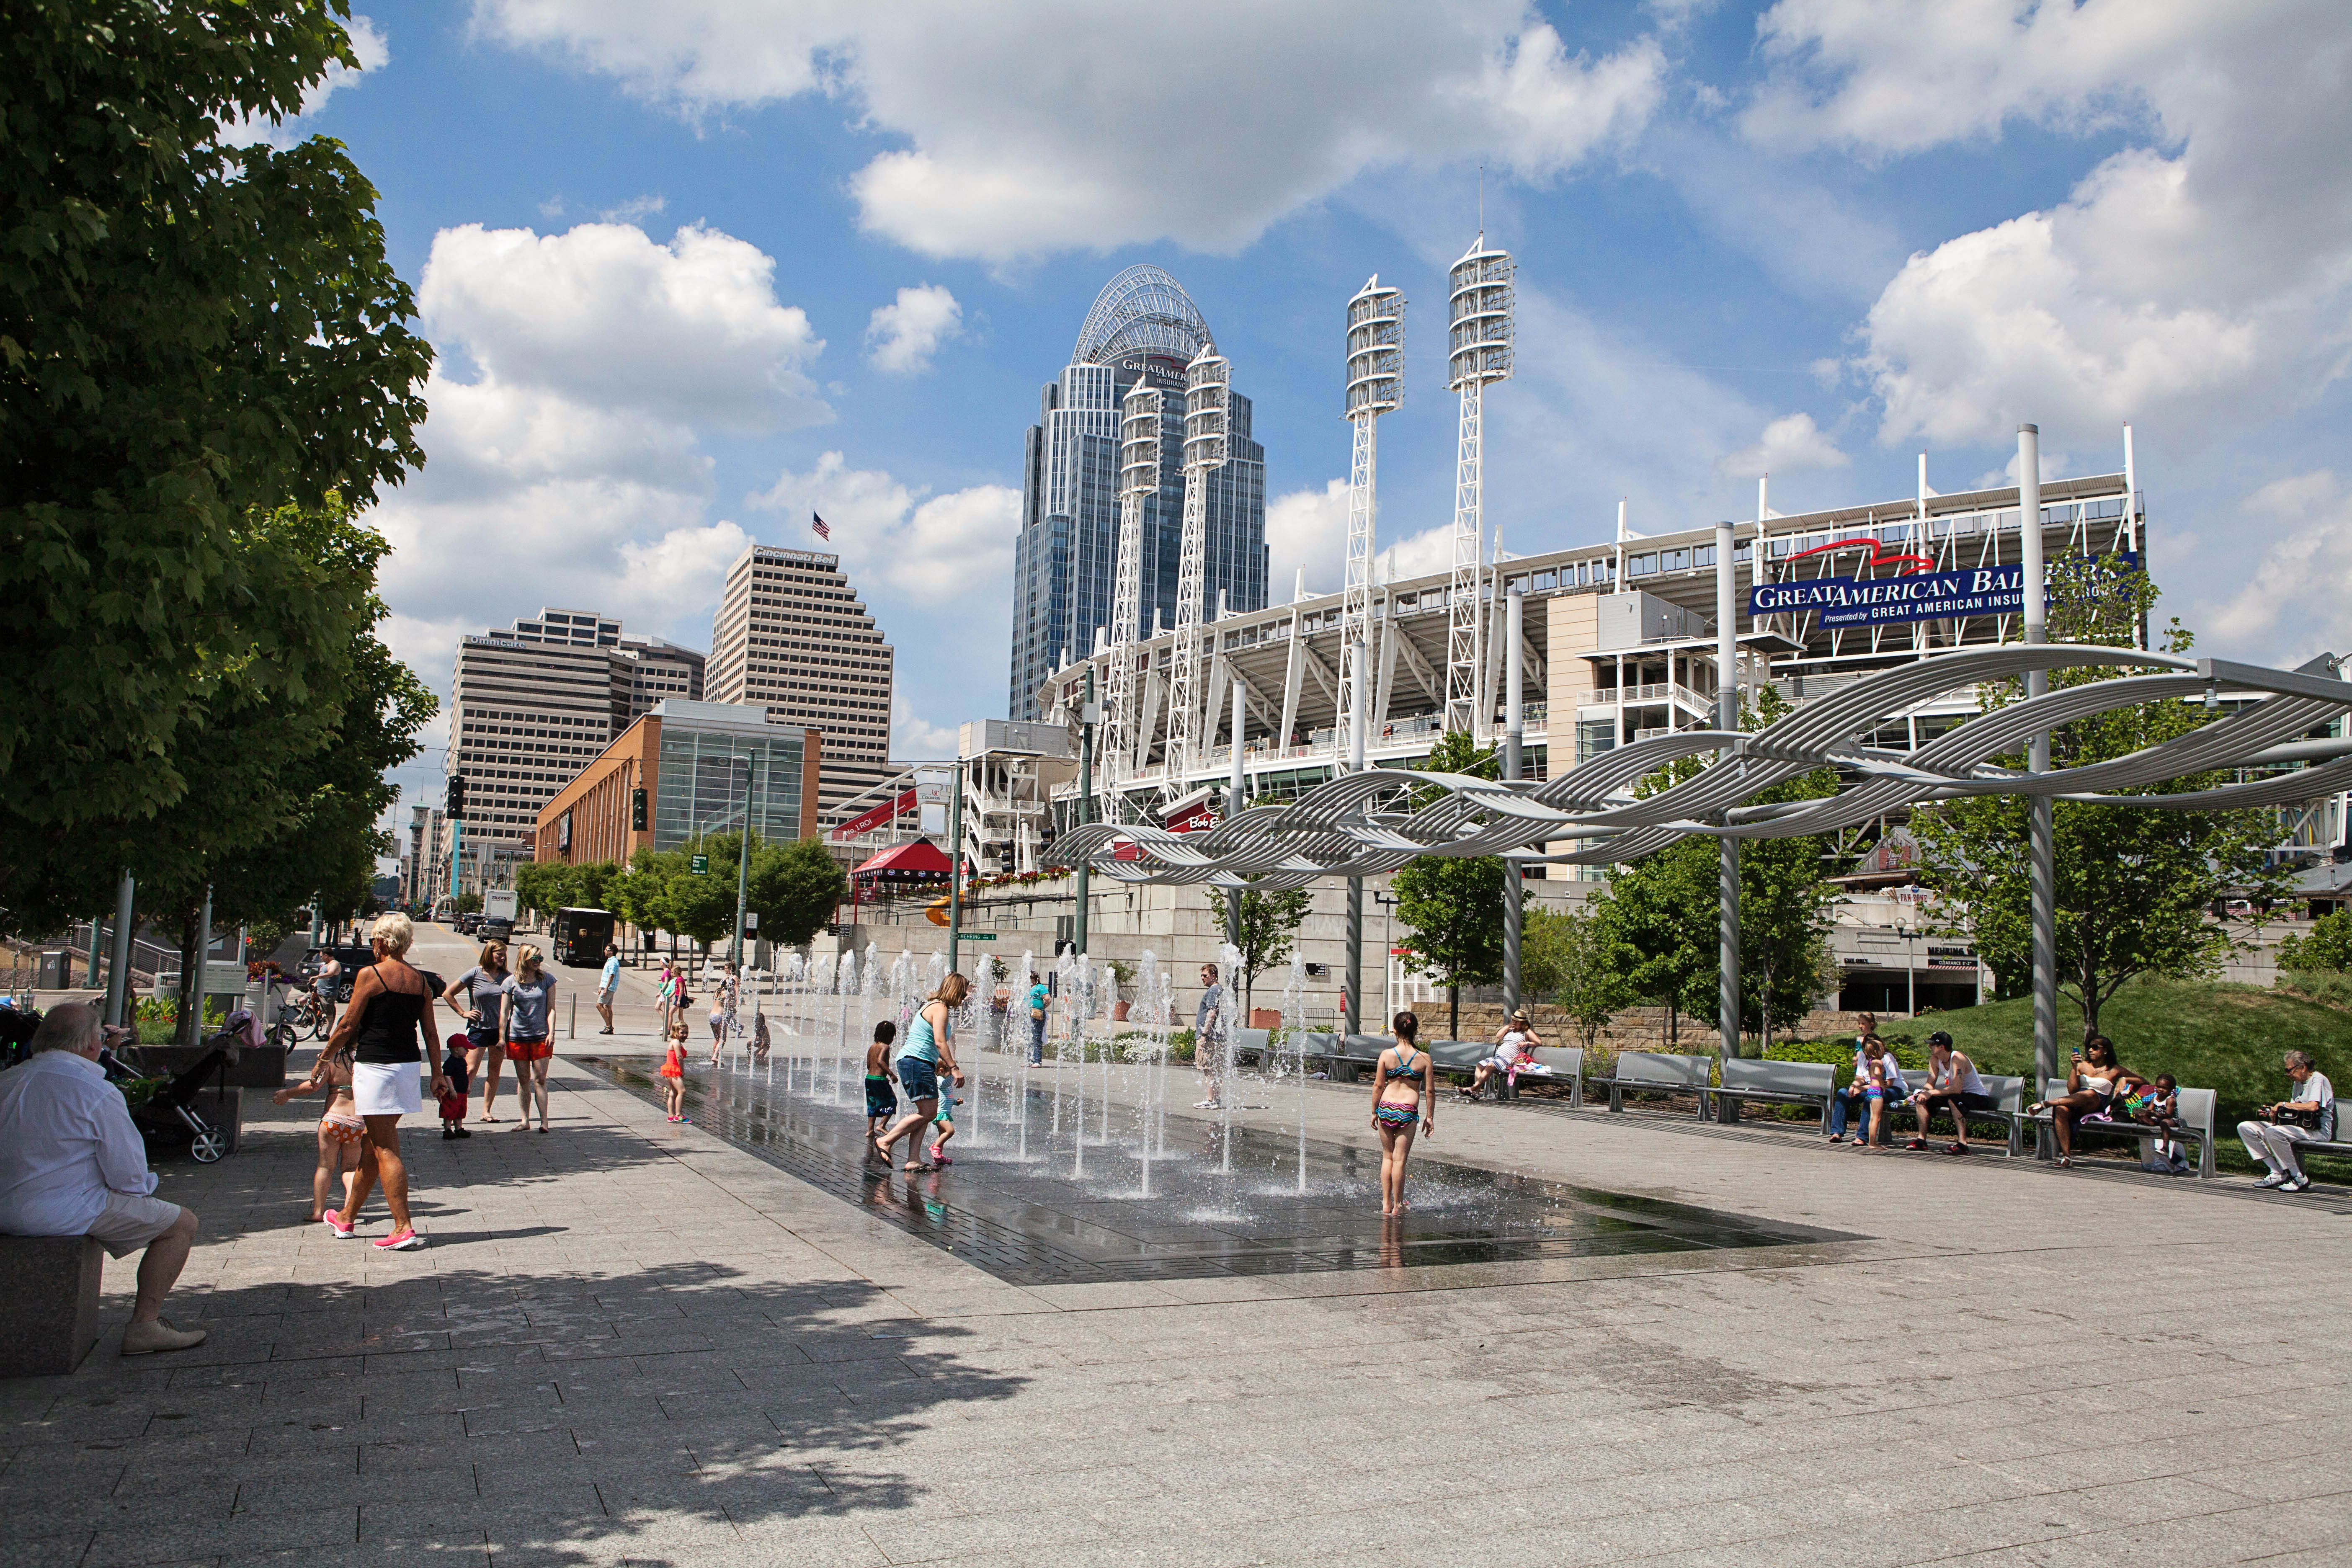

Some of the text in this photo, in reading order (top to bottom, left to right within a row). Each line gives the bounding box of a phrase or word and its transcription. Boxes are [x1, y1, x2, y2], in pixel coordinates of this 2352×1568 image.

[1122, 359, 1186, 382] GREAT AMER
[1157, 377, 1186, 389] INSURANC
[1755, 585, 1836, 608] GREAT
[1828, 578, 1960, 607] AMERICAN
[1970, 570, 2024, 593] BAL
[1824, 613, 1858, 623] Presented
[1872, 605, 1911, 618] GREAT
[1916, 597, 1982, 614] AMERICAN
[859, 818, 872, 828] ROI
[1188, 817, 1209, 828] Bob
[1900, 893, 1911, 902] FAN
[1927, 947, 1964, 955] MEHRING
